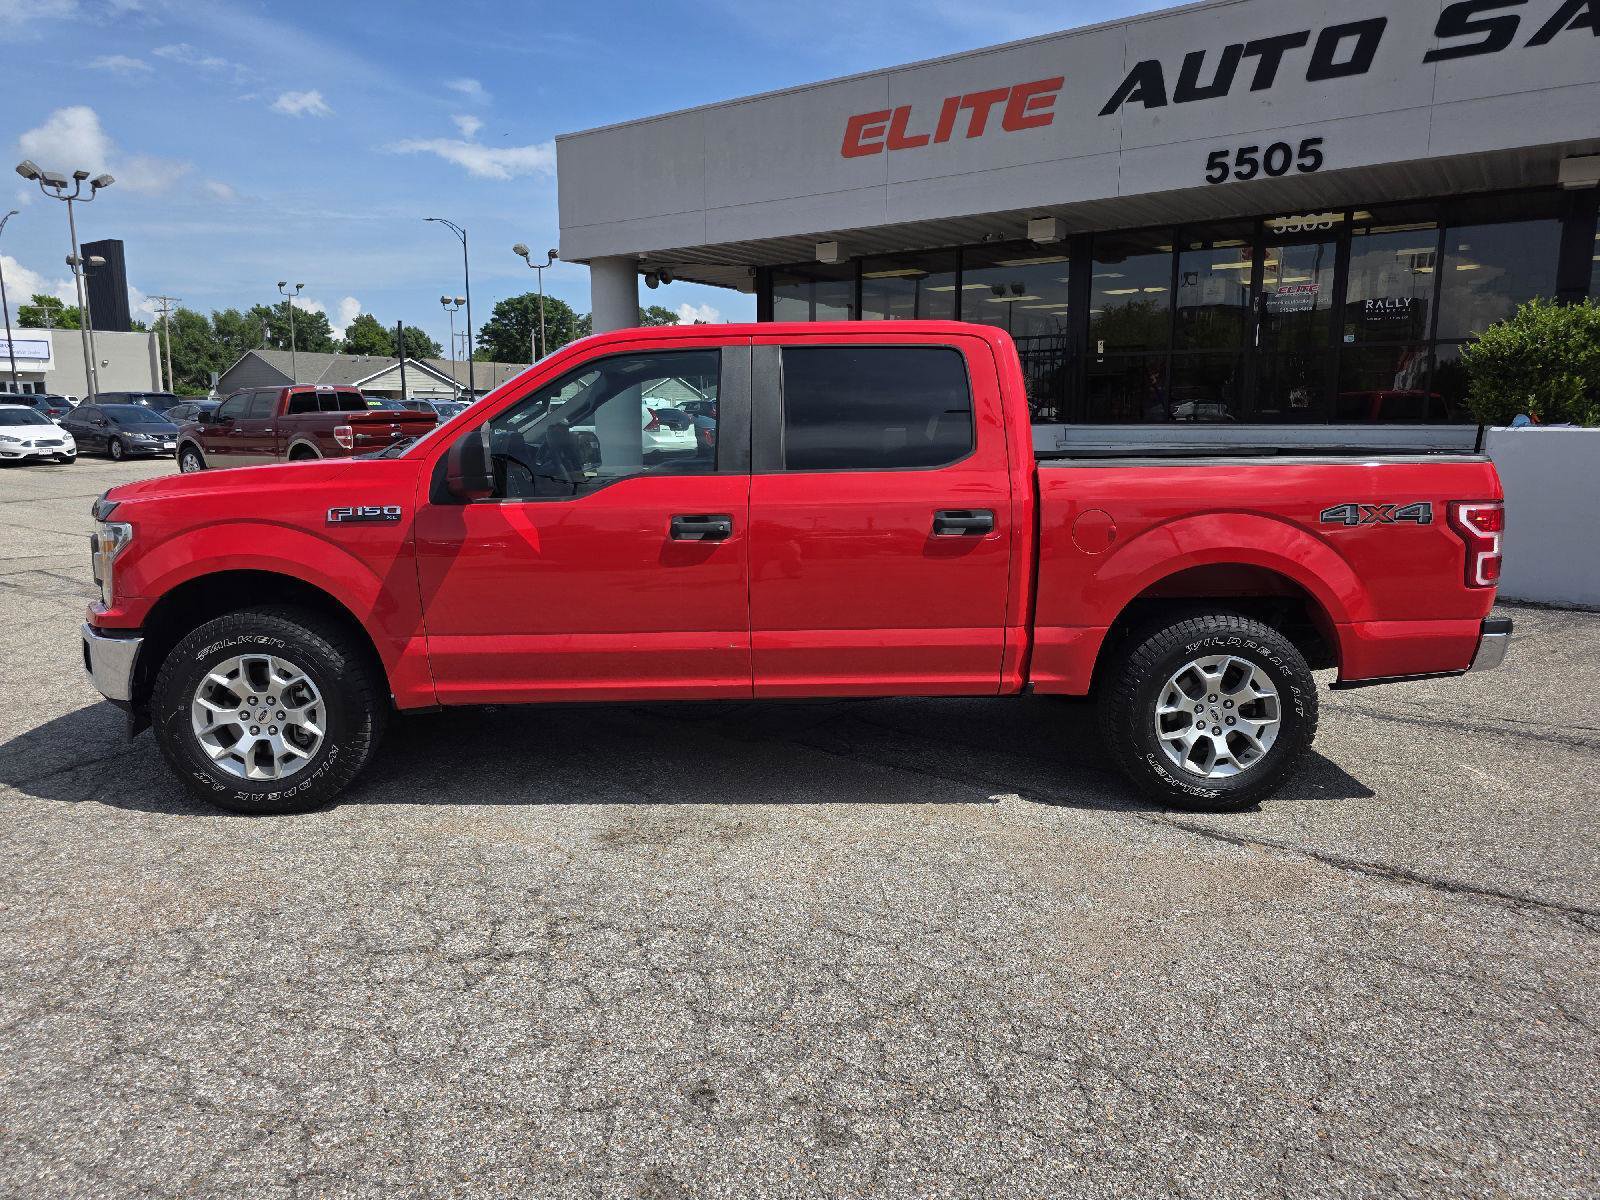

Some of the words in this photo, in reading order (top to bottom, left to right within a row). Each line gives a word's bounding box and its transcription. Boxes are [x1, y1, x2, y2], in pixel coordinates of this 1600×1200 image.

[841, 76, 1065, 158] ELITE
[1098, 16, 1388, 117] AUTO
[1205, 137, 1324, 184] 5505
[1272, 211, 1333, 234] 5505
[1366, 298, 1411, 308] RALLY
[195, 635, 286, 661] FALKEN
[1185, 636, 1293, 676] WILDPEAK
[234, 744, 339, 801] WILDPEAK
